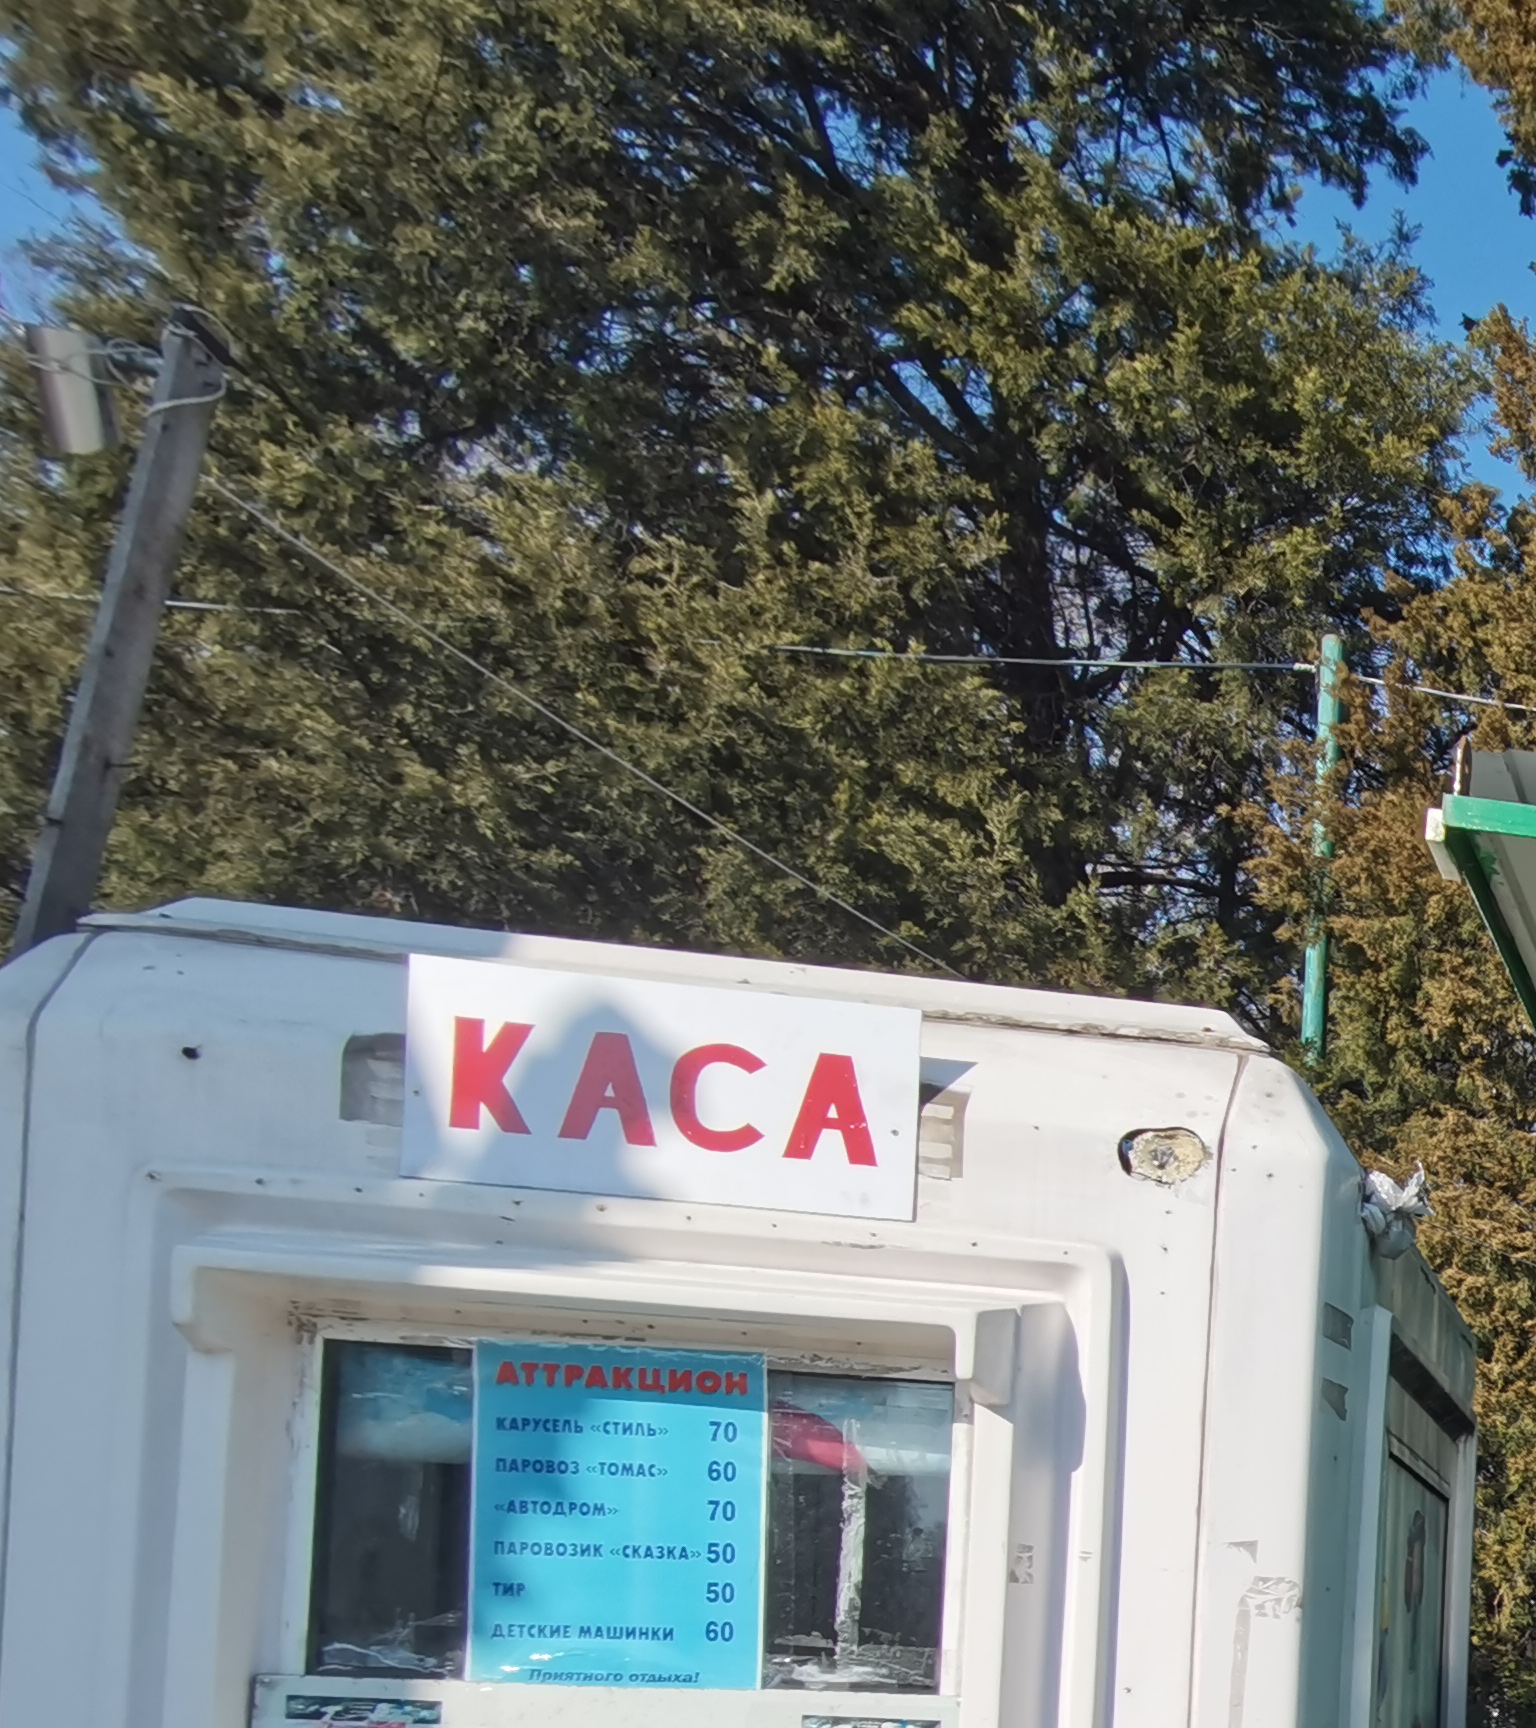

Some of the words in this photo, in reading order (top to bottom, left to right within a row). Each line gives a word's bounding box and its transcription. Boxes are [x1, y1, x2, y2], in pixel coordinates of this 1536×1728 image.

[449, 1015, 878, 1167] КАСА
[495, 1361, 748, 1395] АТТРАКЦИОН
[495, 1417, 584, 1434] КАРУСЕЛЬ
[708, 1420, 738, 1443] 70
[495, 1458, 580, 1475] ПАРОВОЗ
[707, 1460, 737, 1482] 60
[706, 1500, 736, 1522] 70
[494, 1541, 604, 1558] ПАРОВОЗИК
[706, 1542, 736, 1564] 50
[491, 1581, 526, 1597] ТИР
[705, 1581, 735, 1604] 50
[491, 1623, 571, 1640] ДЕТСКИЕ
[577, 1625, 674, 1642] МАШИНКИ
[705, 1620, 734, 1642] 60
[528, 1668, 624, 1684] Приятного
